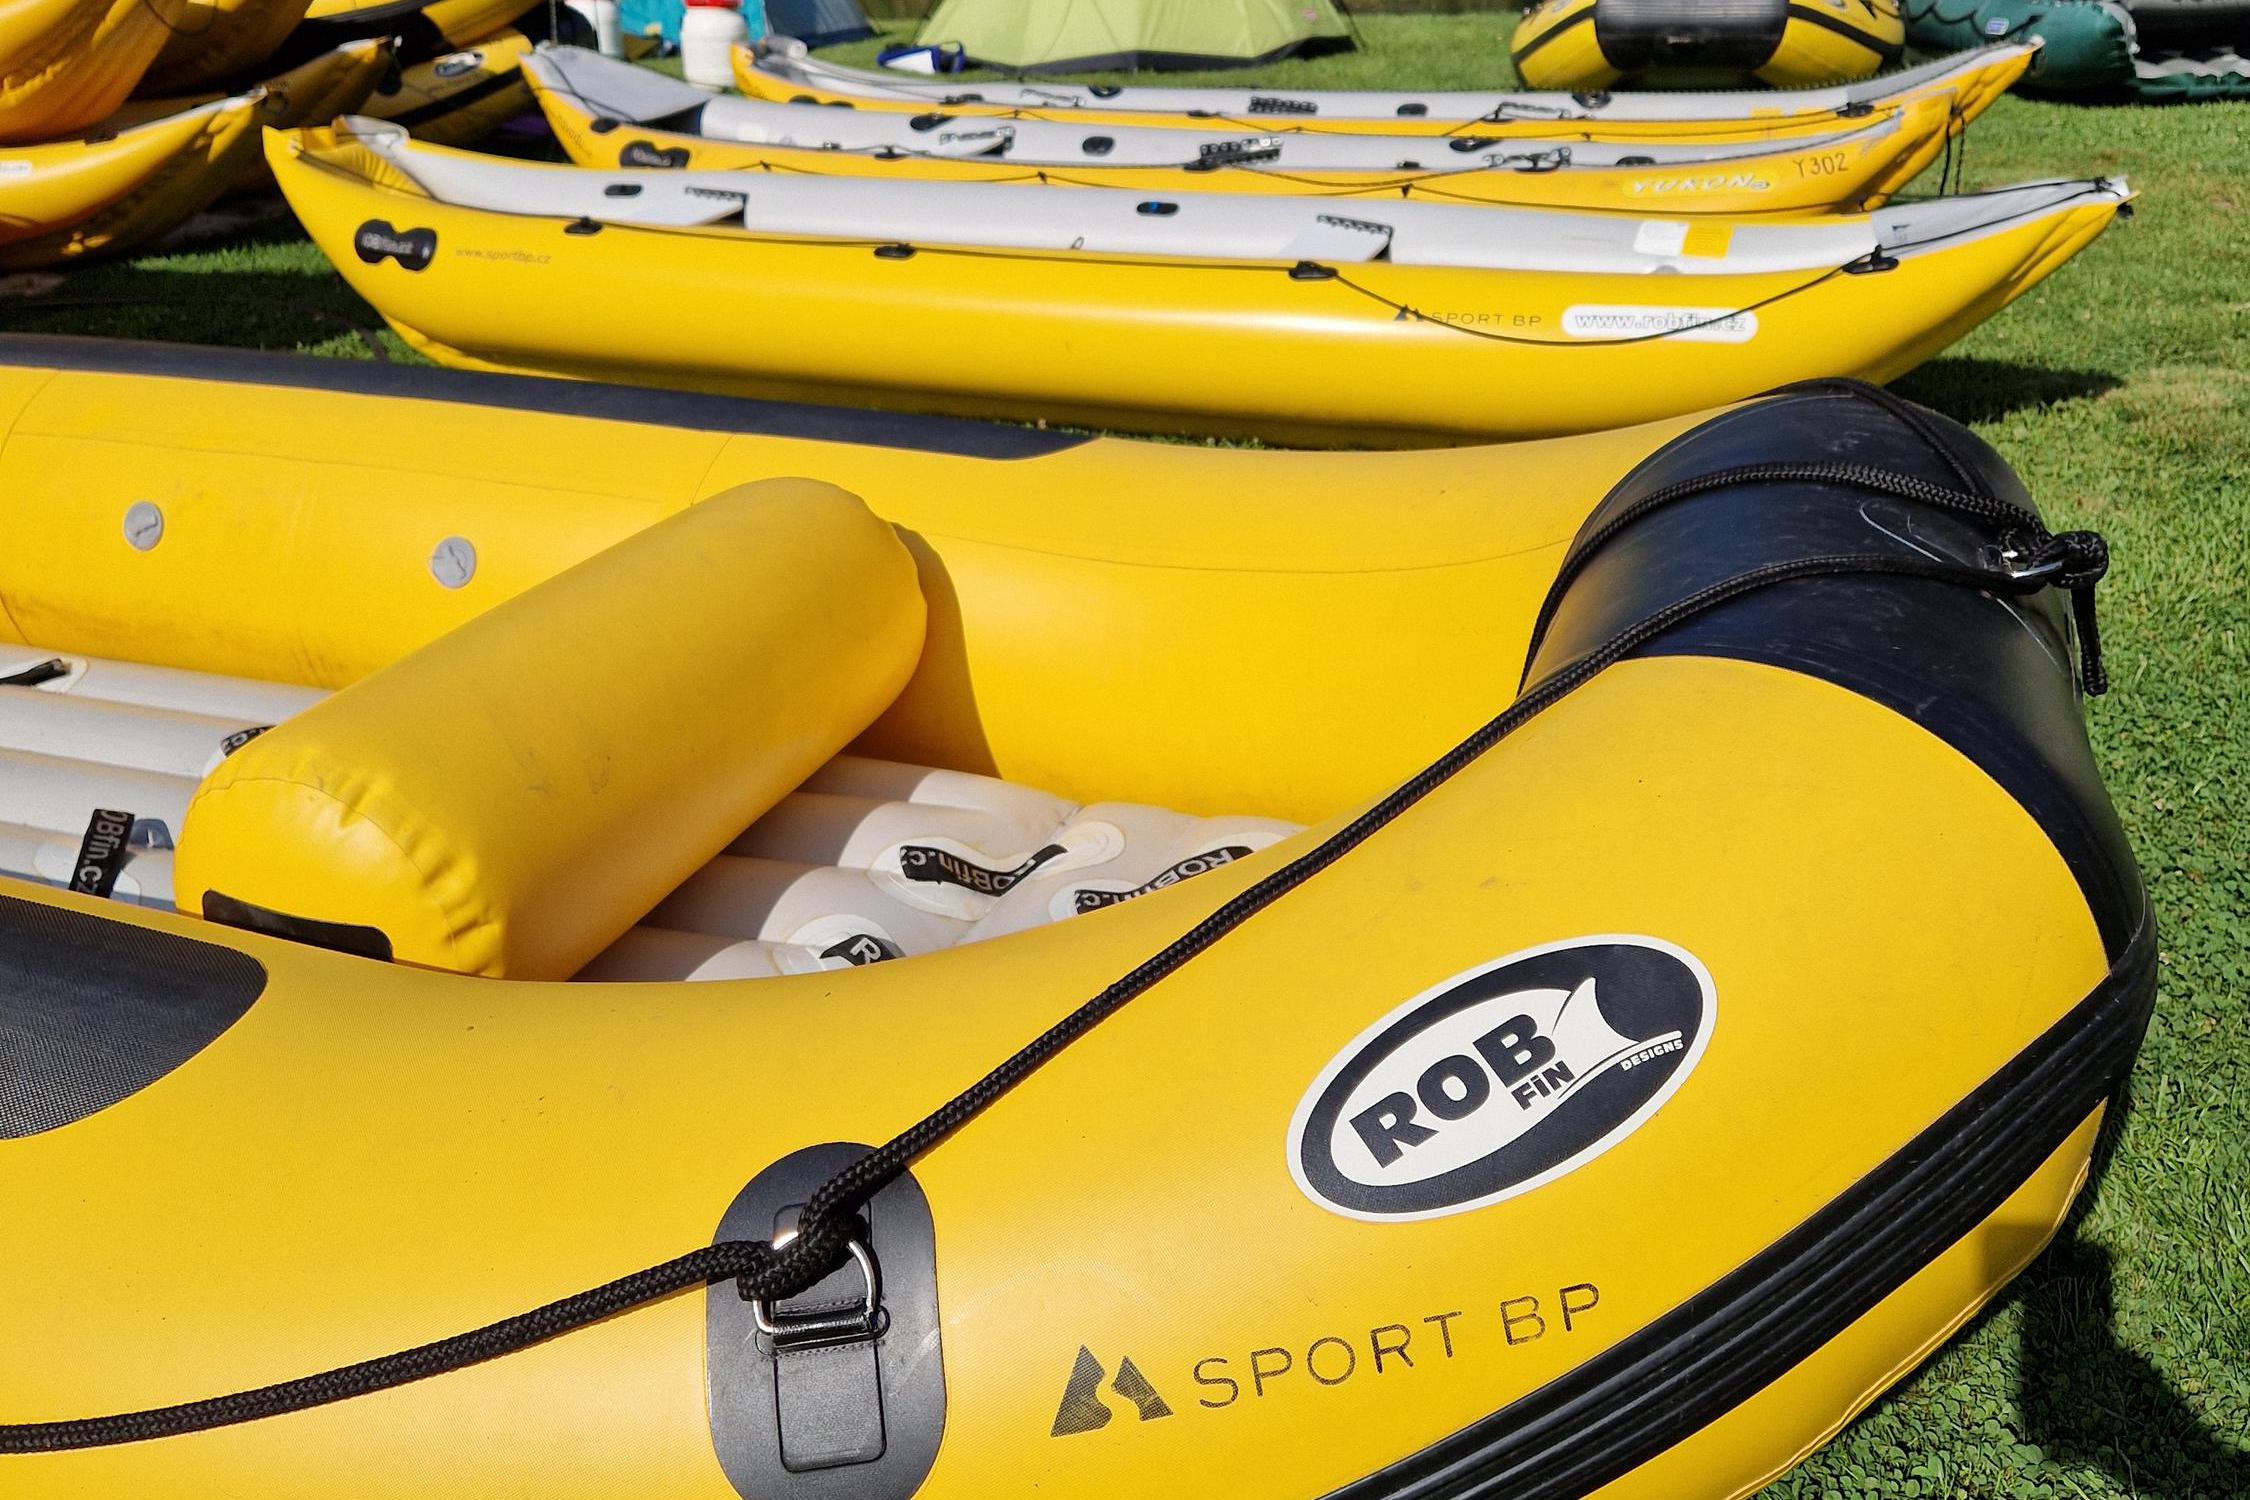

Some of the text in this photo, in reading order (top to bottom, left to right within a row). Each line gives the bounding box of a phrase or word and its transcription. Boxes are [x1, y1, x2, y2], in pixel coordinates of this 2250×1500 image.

[1792, 152, 1849, 179] Y302
[1431, 310, 1542, 327] SPORT BP
[1619, 1039, 1685, 1073] DESIGNS
[1348, 1013, 1557, 1169] ROB
[1192, 1282, 1601, 1409] SPORT BP
